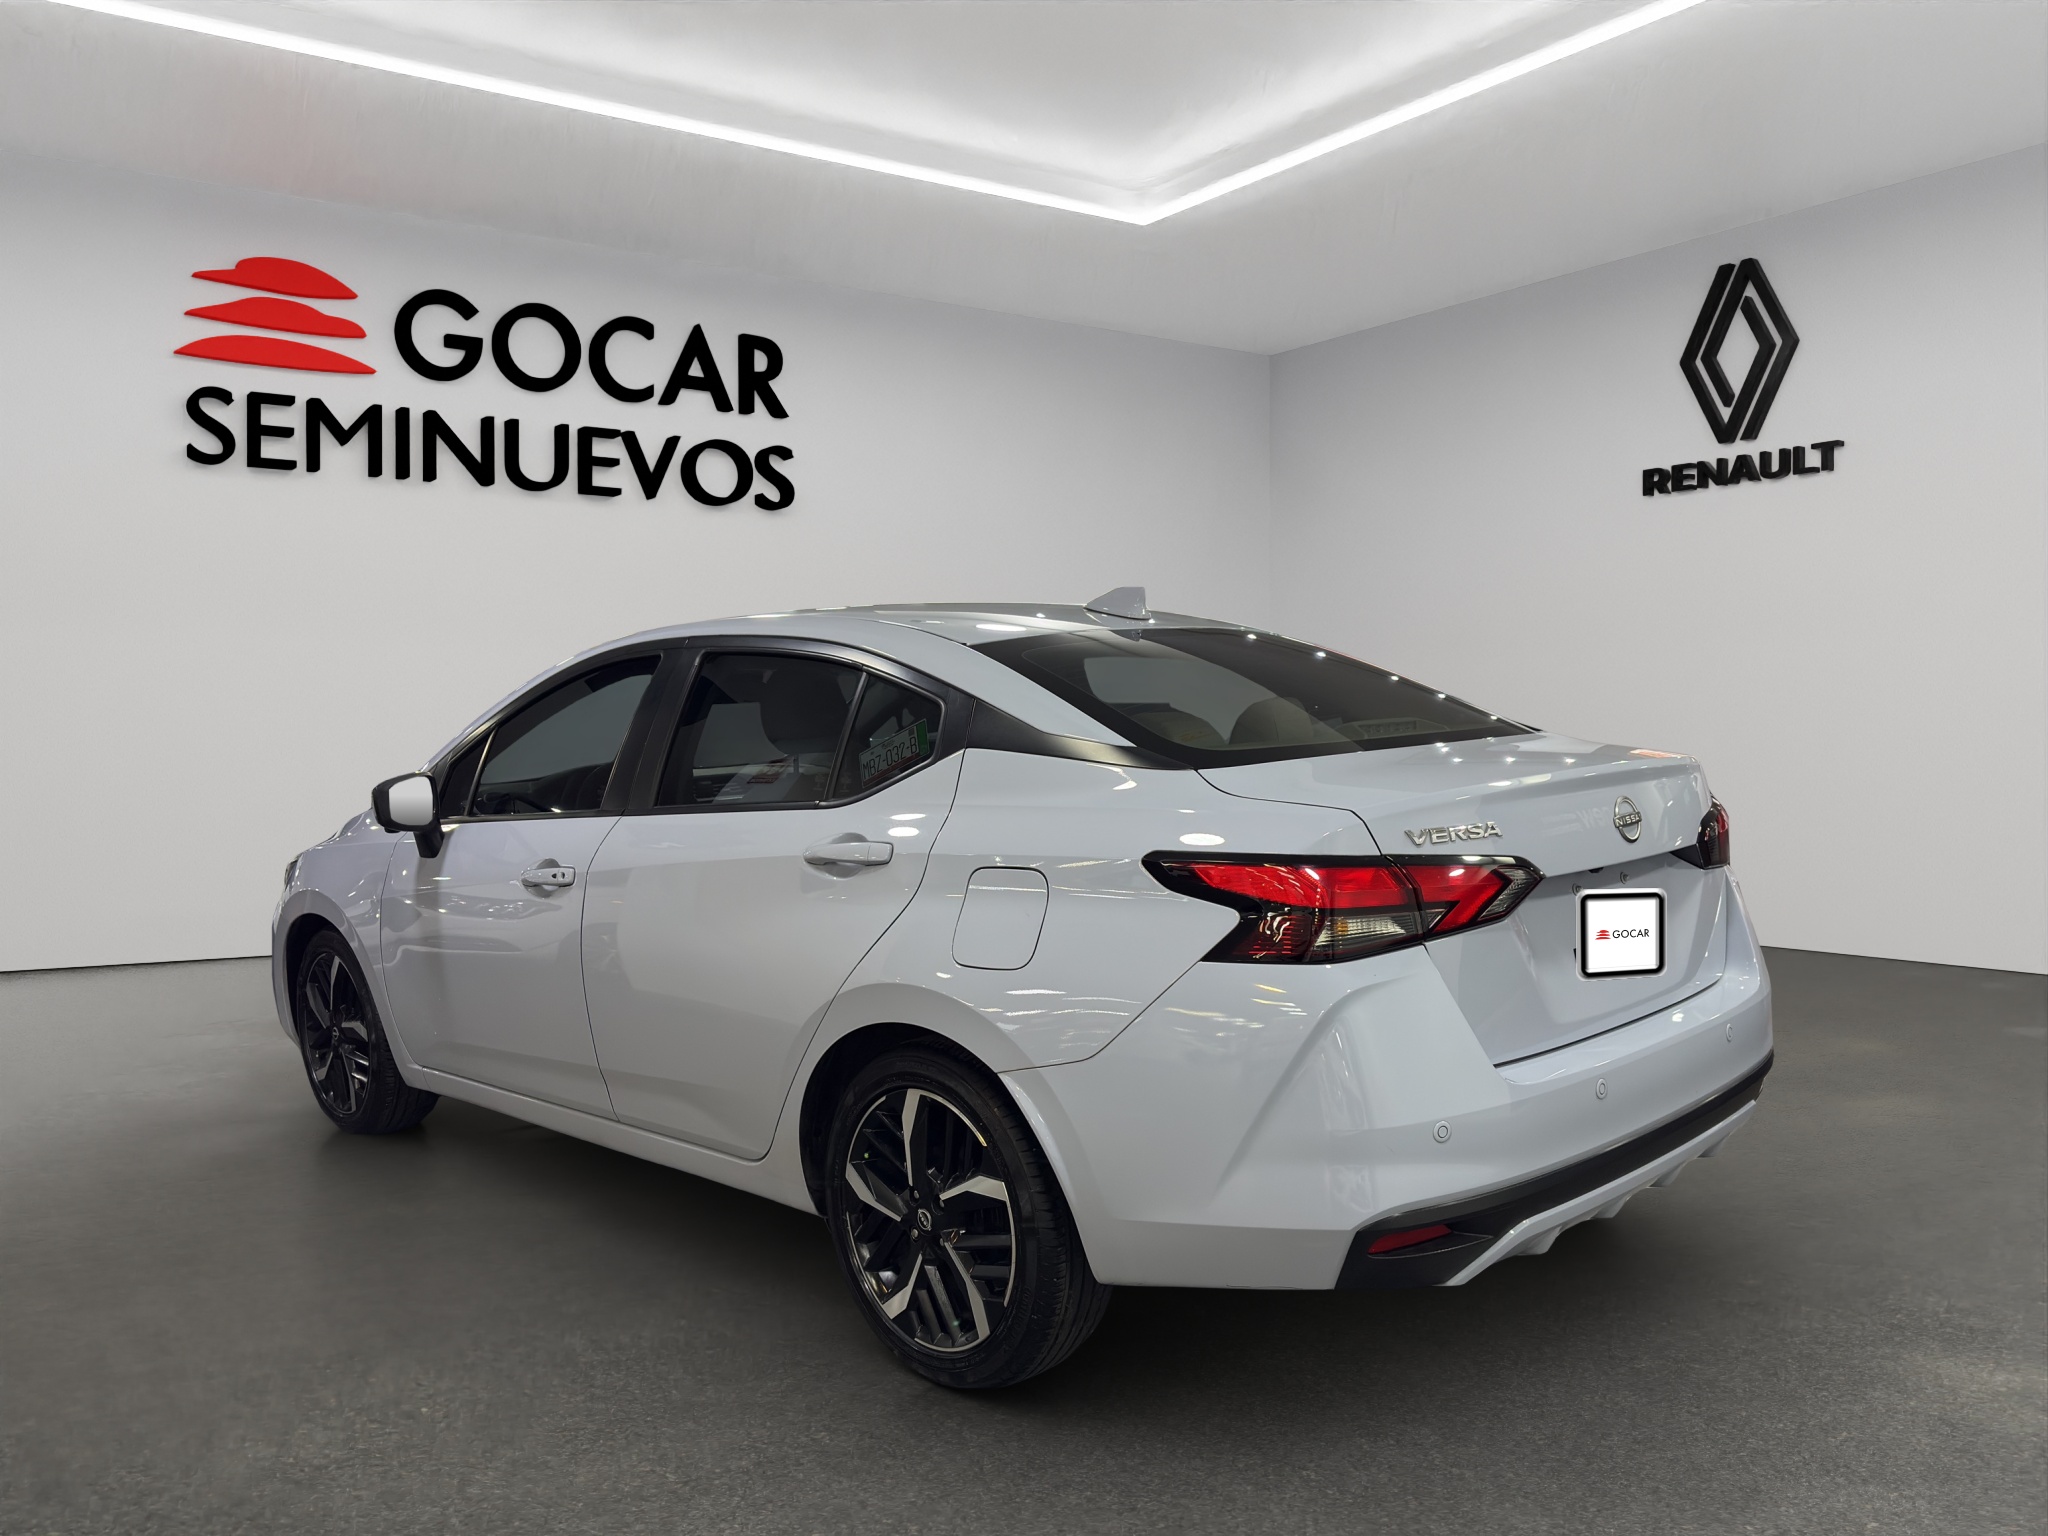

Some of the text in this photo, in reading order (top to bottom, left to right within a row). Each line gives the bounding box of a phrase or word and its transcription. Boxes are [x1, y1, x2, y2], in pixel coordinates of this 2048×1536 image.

[393, 288, 789, 419] GOCAR
[185, 386, 795, 512] SEMINUEVOS
[1642, 440, 1845, 496] RENAULT
[862, 736, 918, 779] MBZ-032-B
[1404, 821, 1503, 847] VERSA
